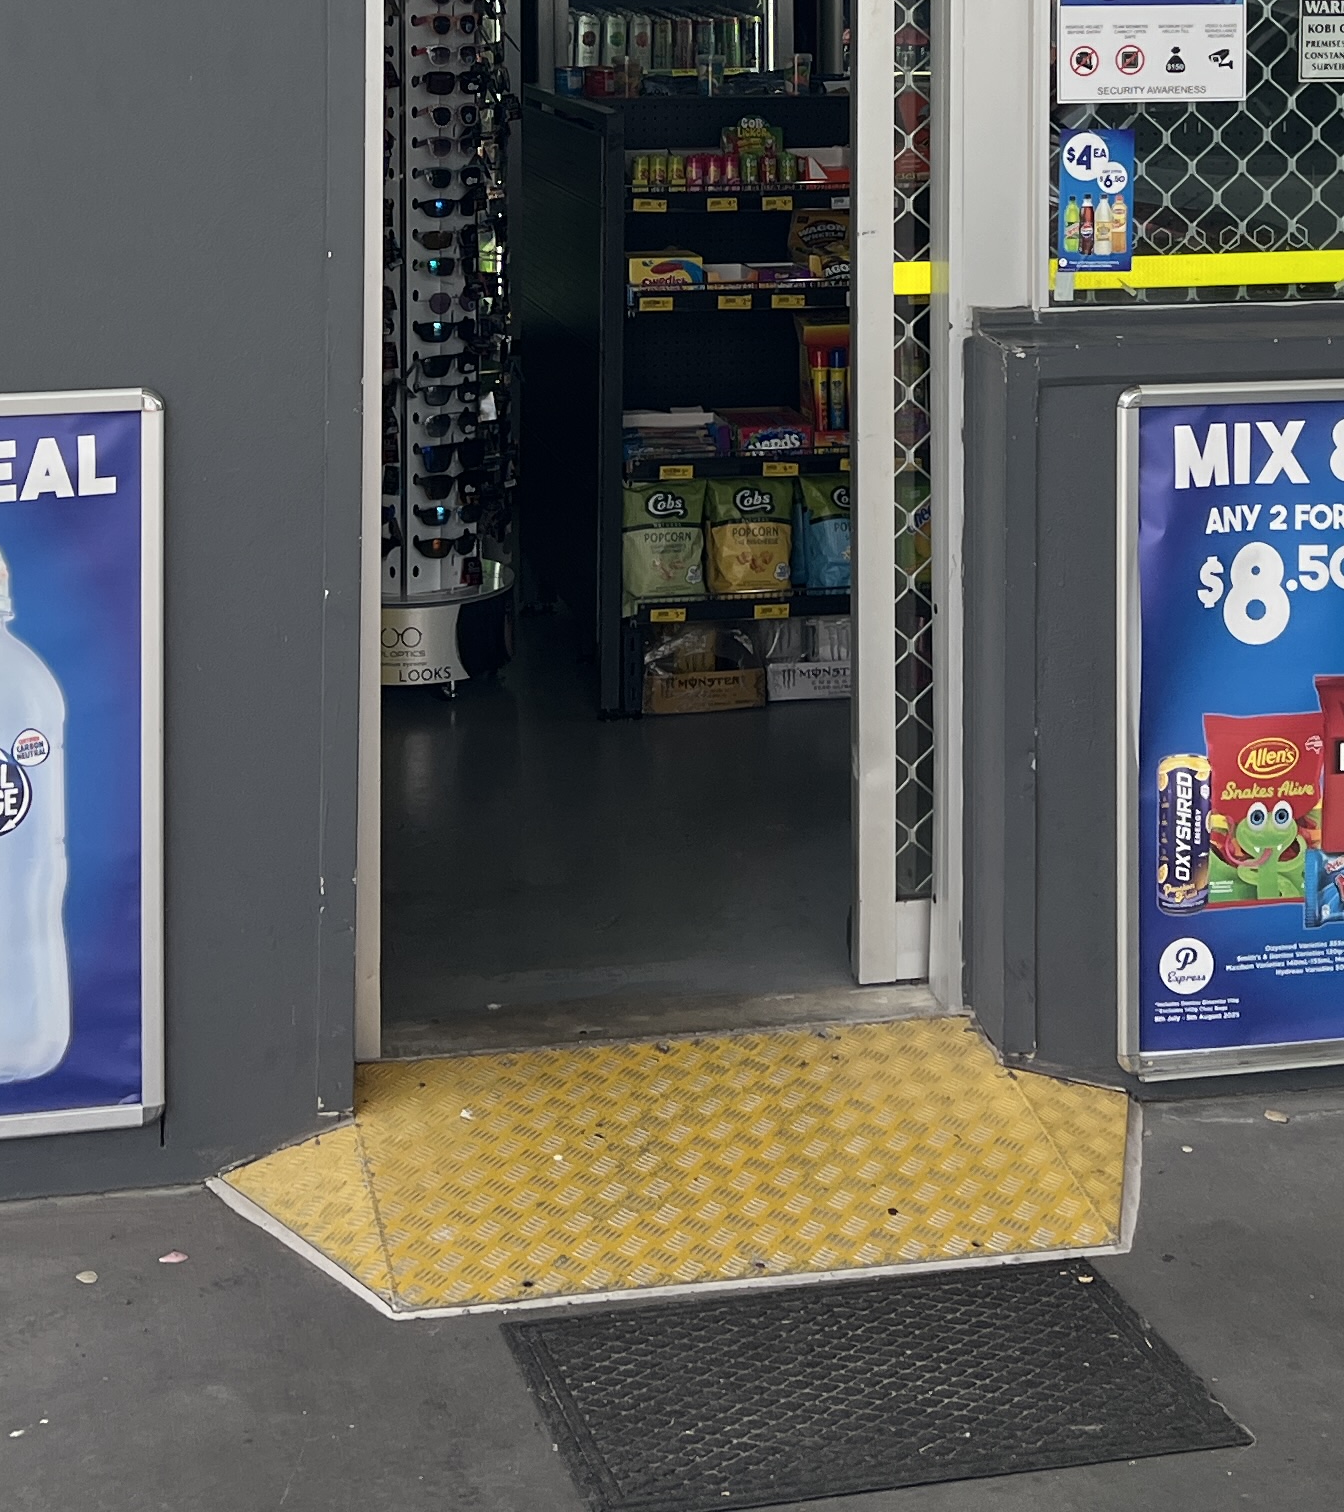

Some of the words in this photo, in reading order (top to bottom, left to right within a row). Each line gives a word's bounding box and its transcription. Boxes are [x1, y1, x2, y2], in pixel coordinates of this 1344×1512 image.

[1307, 23, 1336, 34] KOBI
[1097, 86, 1146, 96] SECURITY
[1146, 85, 1207, 95] AWARENESS
[1066, 144, 1092, 171] $4
[1093, 148, 1107, 158] EA
[798, 223, 846, 237] WAGON
[1173, 419, 1311, 490] MIX
[647, 493, 685, 516] Cobs
[735, 489, 772, 512] Cobs
[1204, 504, 1261, 535] ANY
[1269, 504, 1287, 531] 2
[644, 532, 692, 543] POPCORN
[732, 526, 779, 537] POPCORN
[399, 666, 452, 683] LOOKS
[677, 677, 741, 689] MONSTER
[16, 740, 44, 753] CARBON
[16, 749, 46, 761] NEUTRAL
[1244, 749, 1296, 770] Allen's
[1220, 780, 1274, 801] Snakes
[1277, 780, 1315, 797] Alive
[1175, 771, 1193, 881] OXYSHRED
[1193, 809, 1201, 845] ENERGY
[1175, 947, 1198, 971] P
[1167, 970, 1207, 985] Express
